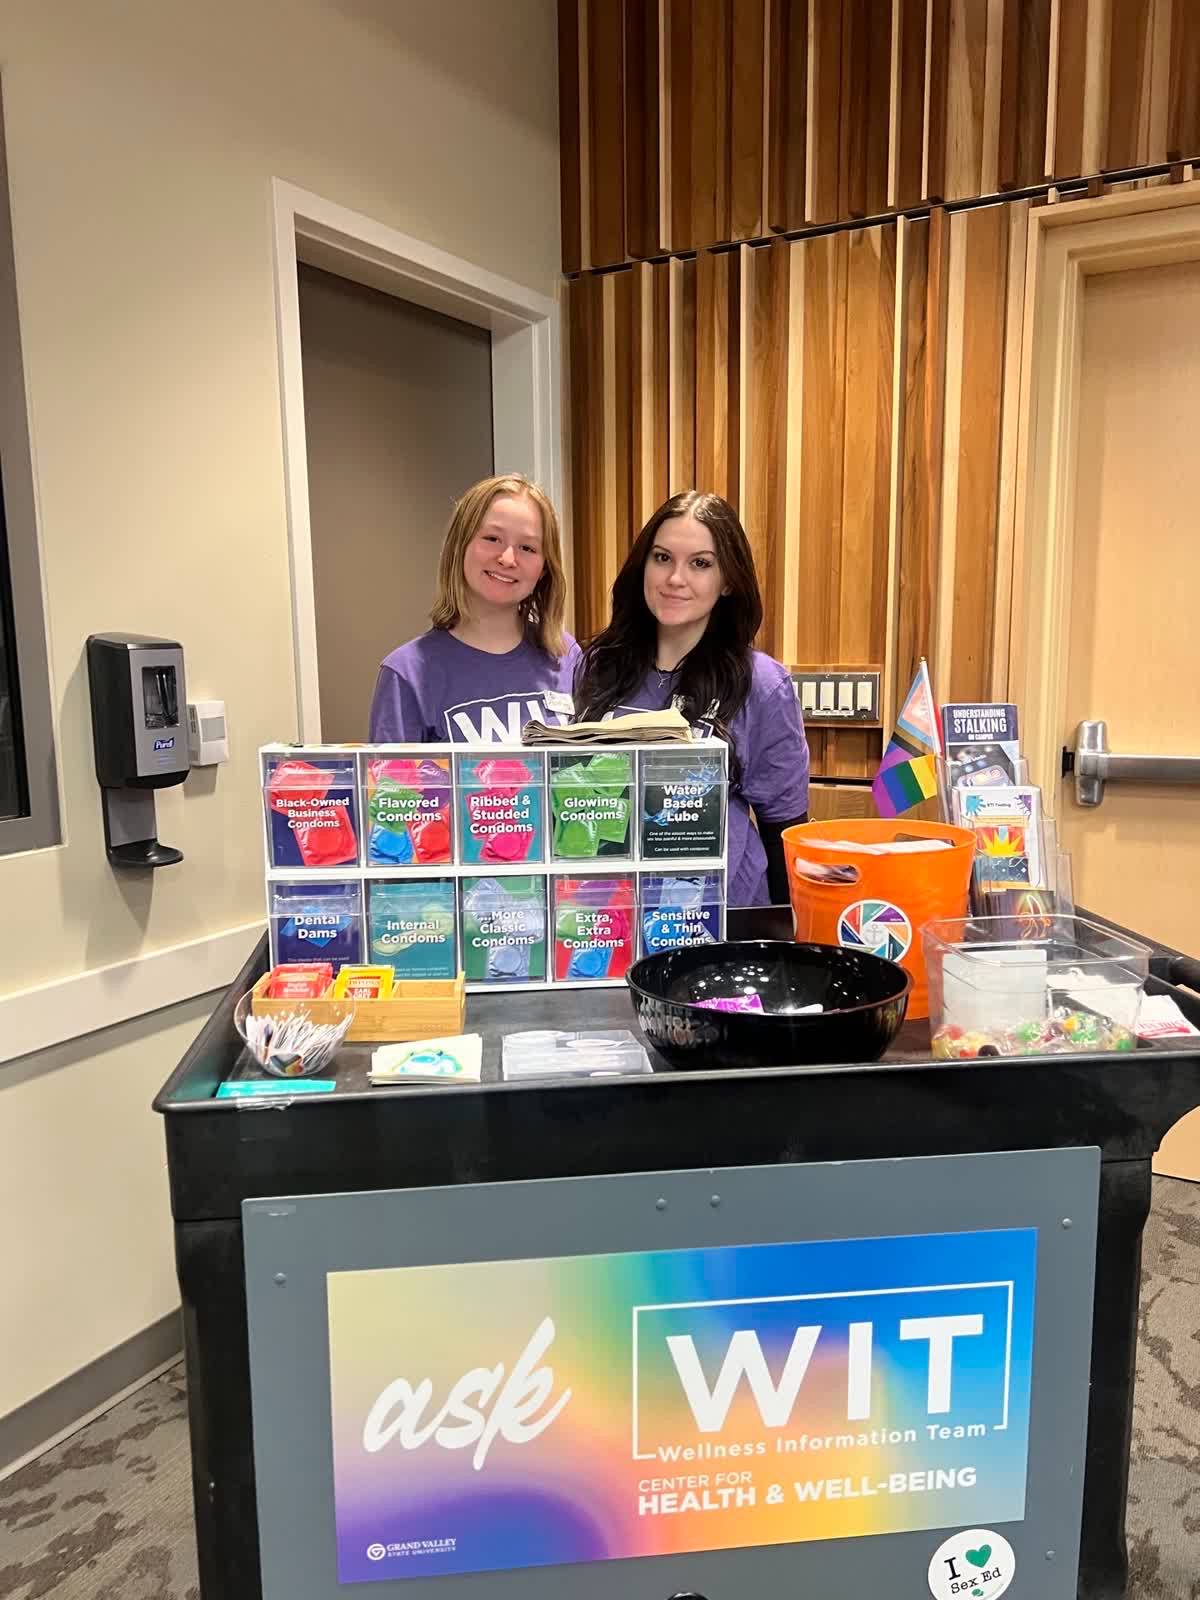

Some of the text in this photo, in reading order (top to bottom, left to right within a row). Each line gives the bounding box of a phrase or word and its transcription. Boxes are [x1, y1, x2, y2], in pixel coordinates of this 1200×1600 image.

[953, 709, 1006, 718] UNDERSTANDING
[954, 718, 1007, 733] STALKING
[663, 785, 704, 795] Water
[276, 797, 350, 808] Black-Owned
[379, 797, 439, 808] Flavored
[470, 794, 531, 807] Ribbed &
[564, 797, 618, 810] Glowing
[663, 797, 703, 808] Based
[287, 809, 336, 818] Business
[377, 811, 442, 822] Condoms
[472, 808, 529, 820] Studded
[560, 810, 623, 821] Condoms
[667, 811, 699, 821] Lube
[287, 819, 340, 828] Condoms
[470, 822, 533, 834] Condoms
[294, 914, 340, 926] Dental
[575, 913, 613, 925] Extra,
[652, 910, 711, 921] Sensitive
[387, 920, 439, 931] Internal
[479, 921, 526, 934] Classic
[577, 925, 611, 936] Extra
[661, 922, 701, 934] & Thin
[297, 928, 337, 939] Dams
[381, 932, 446, 944] Condoms
[472, 935, 535, 947] Condoms
[563, 938, 624, 949] Condoms
[651, 935, 711, 947] Condoms
[362, 1313, 984, 1471] ask WIT
[657, 1423, 986, 1463] Wellness Information Team
[638, 1470, 753, 1493] CENTER FOR
[638, 1466, 977, 1516] HEALTH & WELL-BEING
[386, 1538, 457, 1552] GRAND VALLEY
[412, 1547, 456, 1555] UNIVERSITY
[943, 1556, 961, 1580] I
[950, 1567, 1002, 1594] Sex Ed
